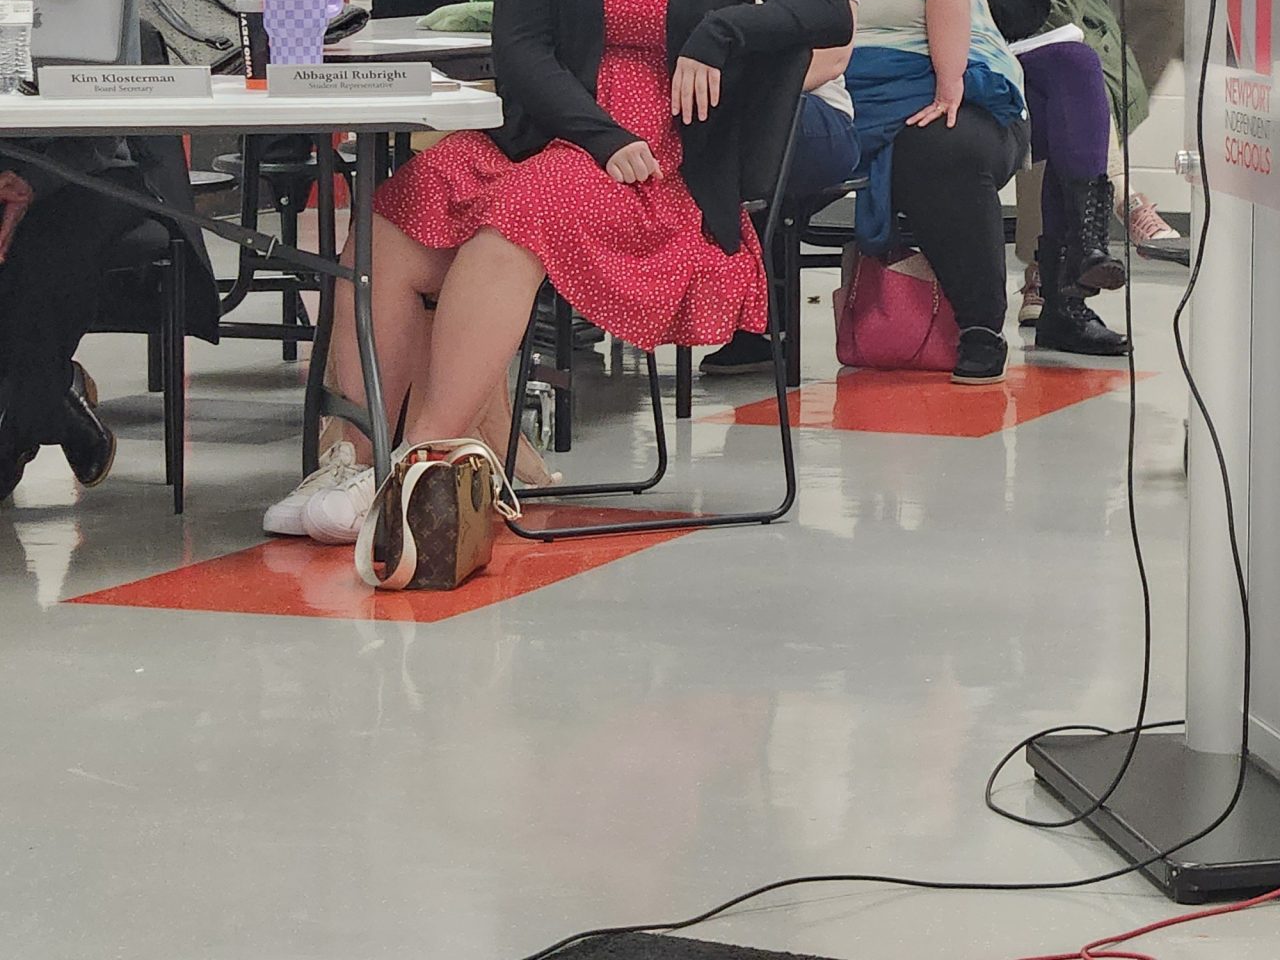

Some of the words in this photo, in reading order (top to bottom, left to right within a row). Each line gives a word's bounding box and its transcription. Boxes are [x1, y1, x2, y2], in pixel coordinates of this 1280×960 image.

[244, 47, 253, 78] WHO
[71, 74, 97, 83] Kim
[102, 74, 175, 83] Klosterman
[293, 71, 348, 82] Abbagail
[352, 70, 407, 83] Rubright
[340, 82, 394, 90] Representative
[118, 85, 154, 93] Secretary
[1225, 77, 1271, 112] NEWPORT
[1225, 109, 1271, 140] INDEPENDENT
[1225, 138, 1271, 175] SCHOOLS
